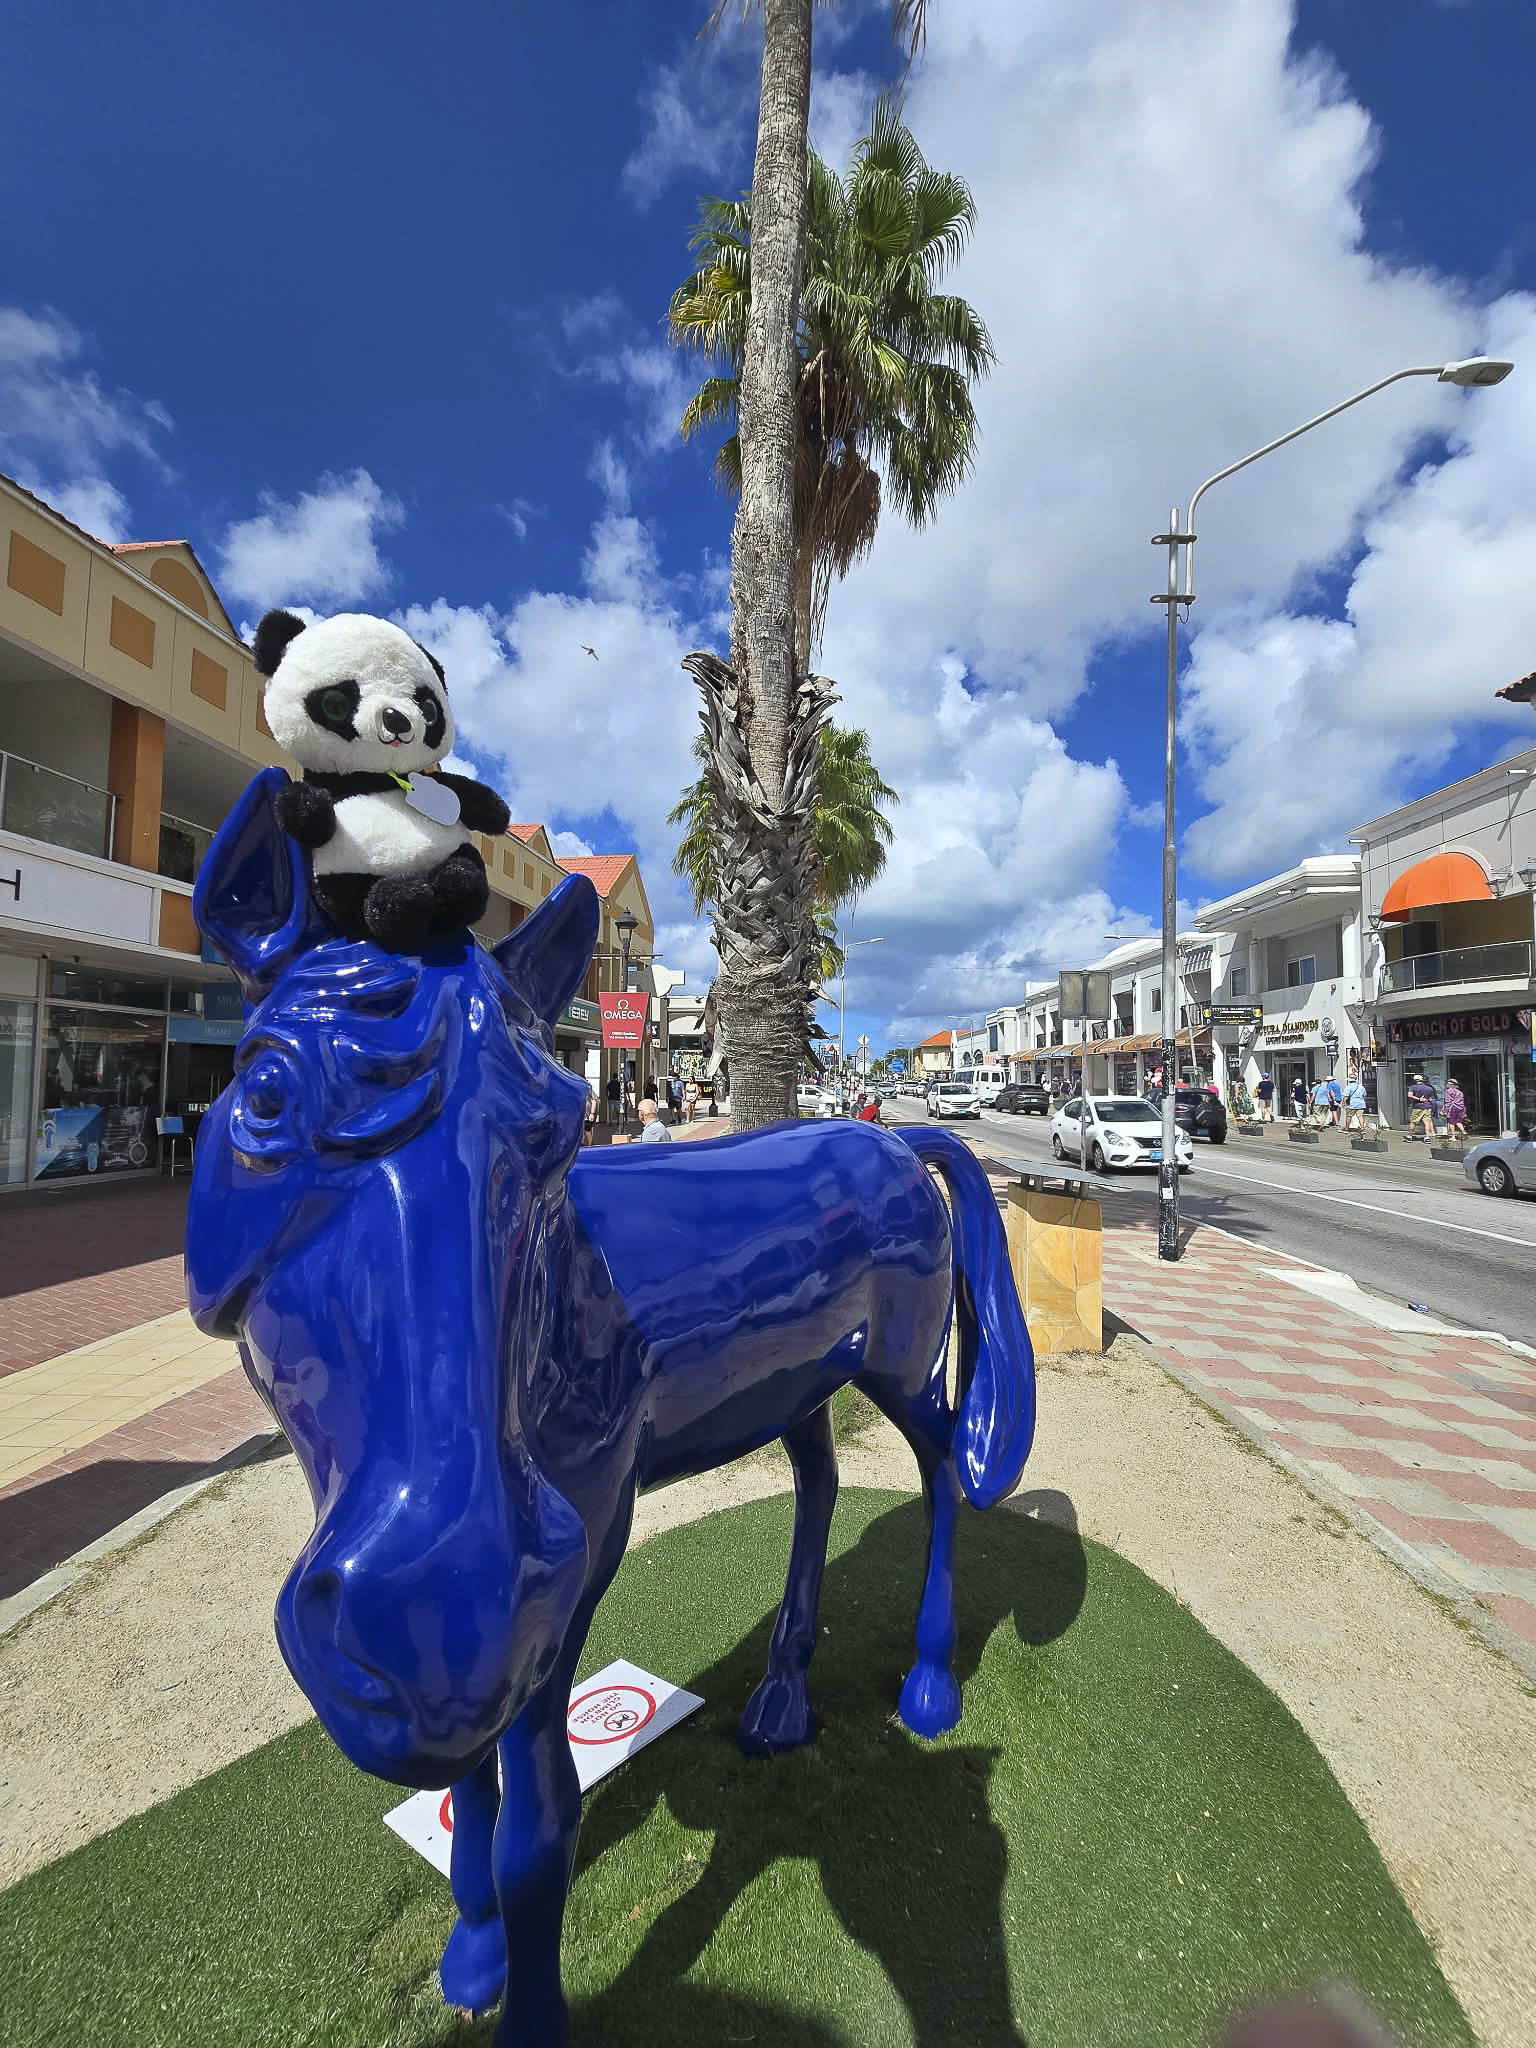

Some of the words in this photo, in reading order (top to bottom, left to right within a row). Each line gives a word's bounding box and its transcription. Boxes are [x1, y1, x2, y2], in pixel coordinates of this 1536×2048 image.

[603, 1010, 643, 1020] OMEGA
[1282, 1019, 1319, 1032] DIAMONDS
[1407, 1020, 1447, 1037] TOUCH
[1450, 1018, 1466, 1034] OF
[1471, 1013, 1510, 1031] GOLD
[601, 1692, 618, 1703] THE
[594, 1696, 620, 1714] CLIMB
[609, 1702, 622, 1711] DO
[572, 1703, 600, 1723] HORSE
[580, 1714, 593, 1724] ON
[592, 1711, 608, 1724] NOT
